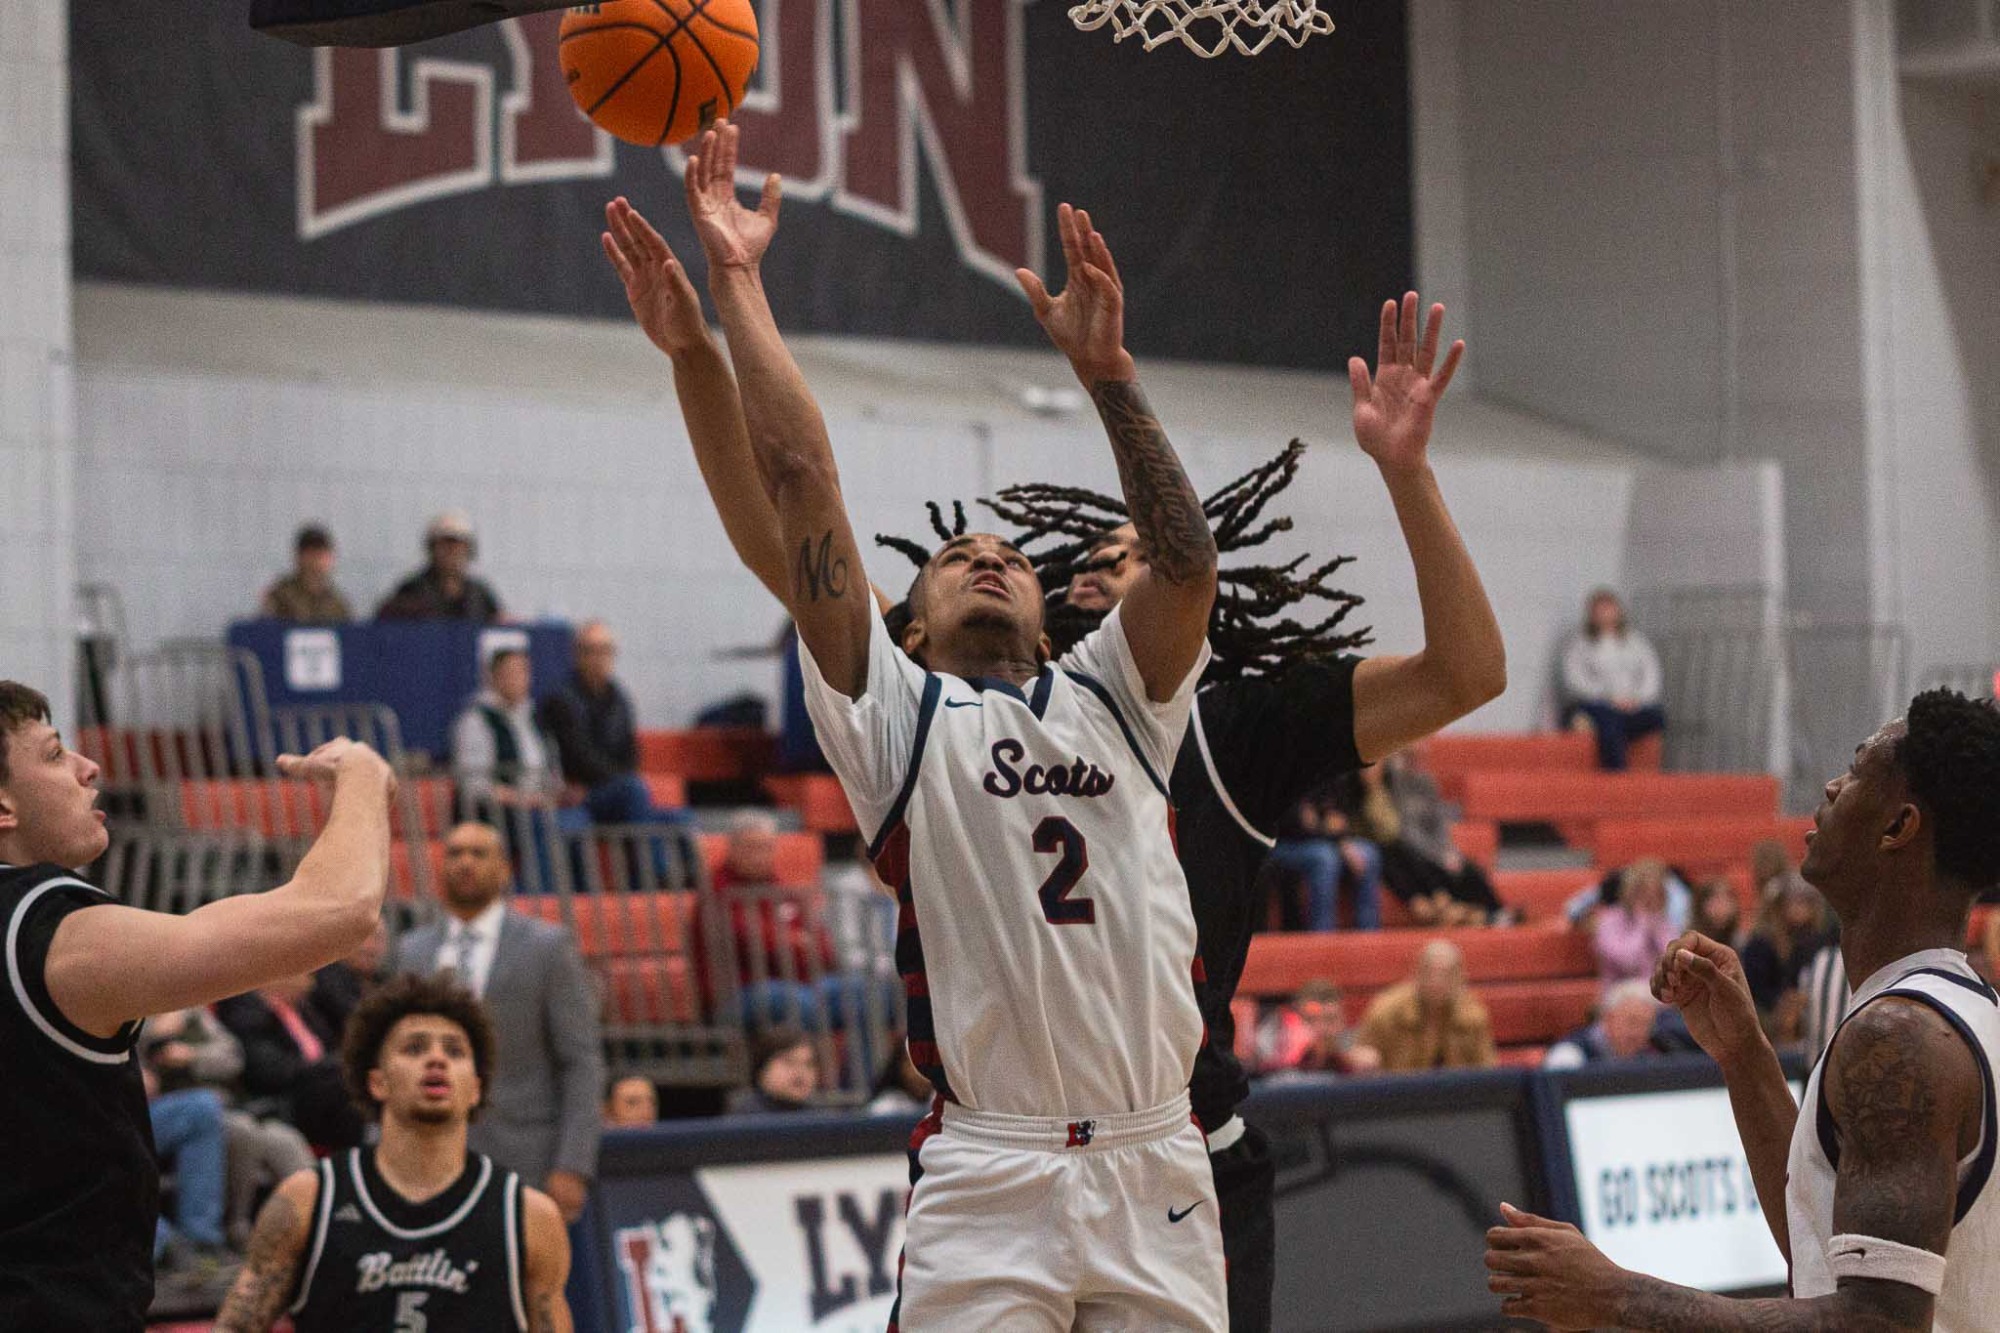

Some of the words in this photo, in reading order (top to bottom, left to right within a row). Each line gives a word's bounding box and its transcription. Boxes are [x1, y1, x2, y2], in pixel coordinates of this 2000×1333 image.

[983, 737, 1116, 798] Scots
[1031, 815, 1096, 925] 2
[1598, 1164, 1639, 1230] GO
[1645, 1156, 1738, 1224] SCOTS
[394, 1290, 429, 1333] 5
